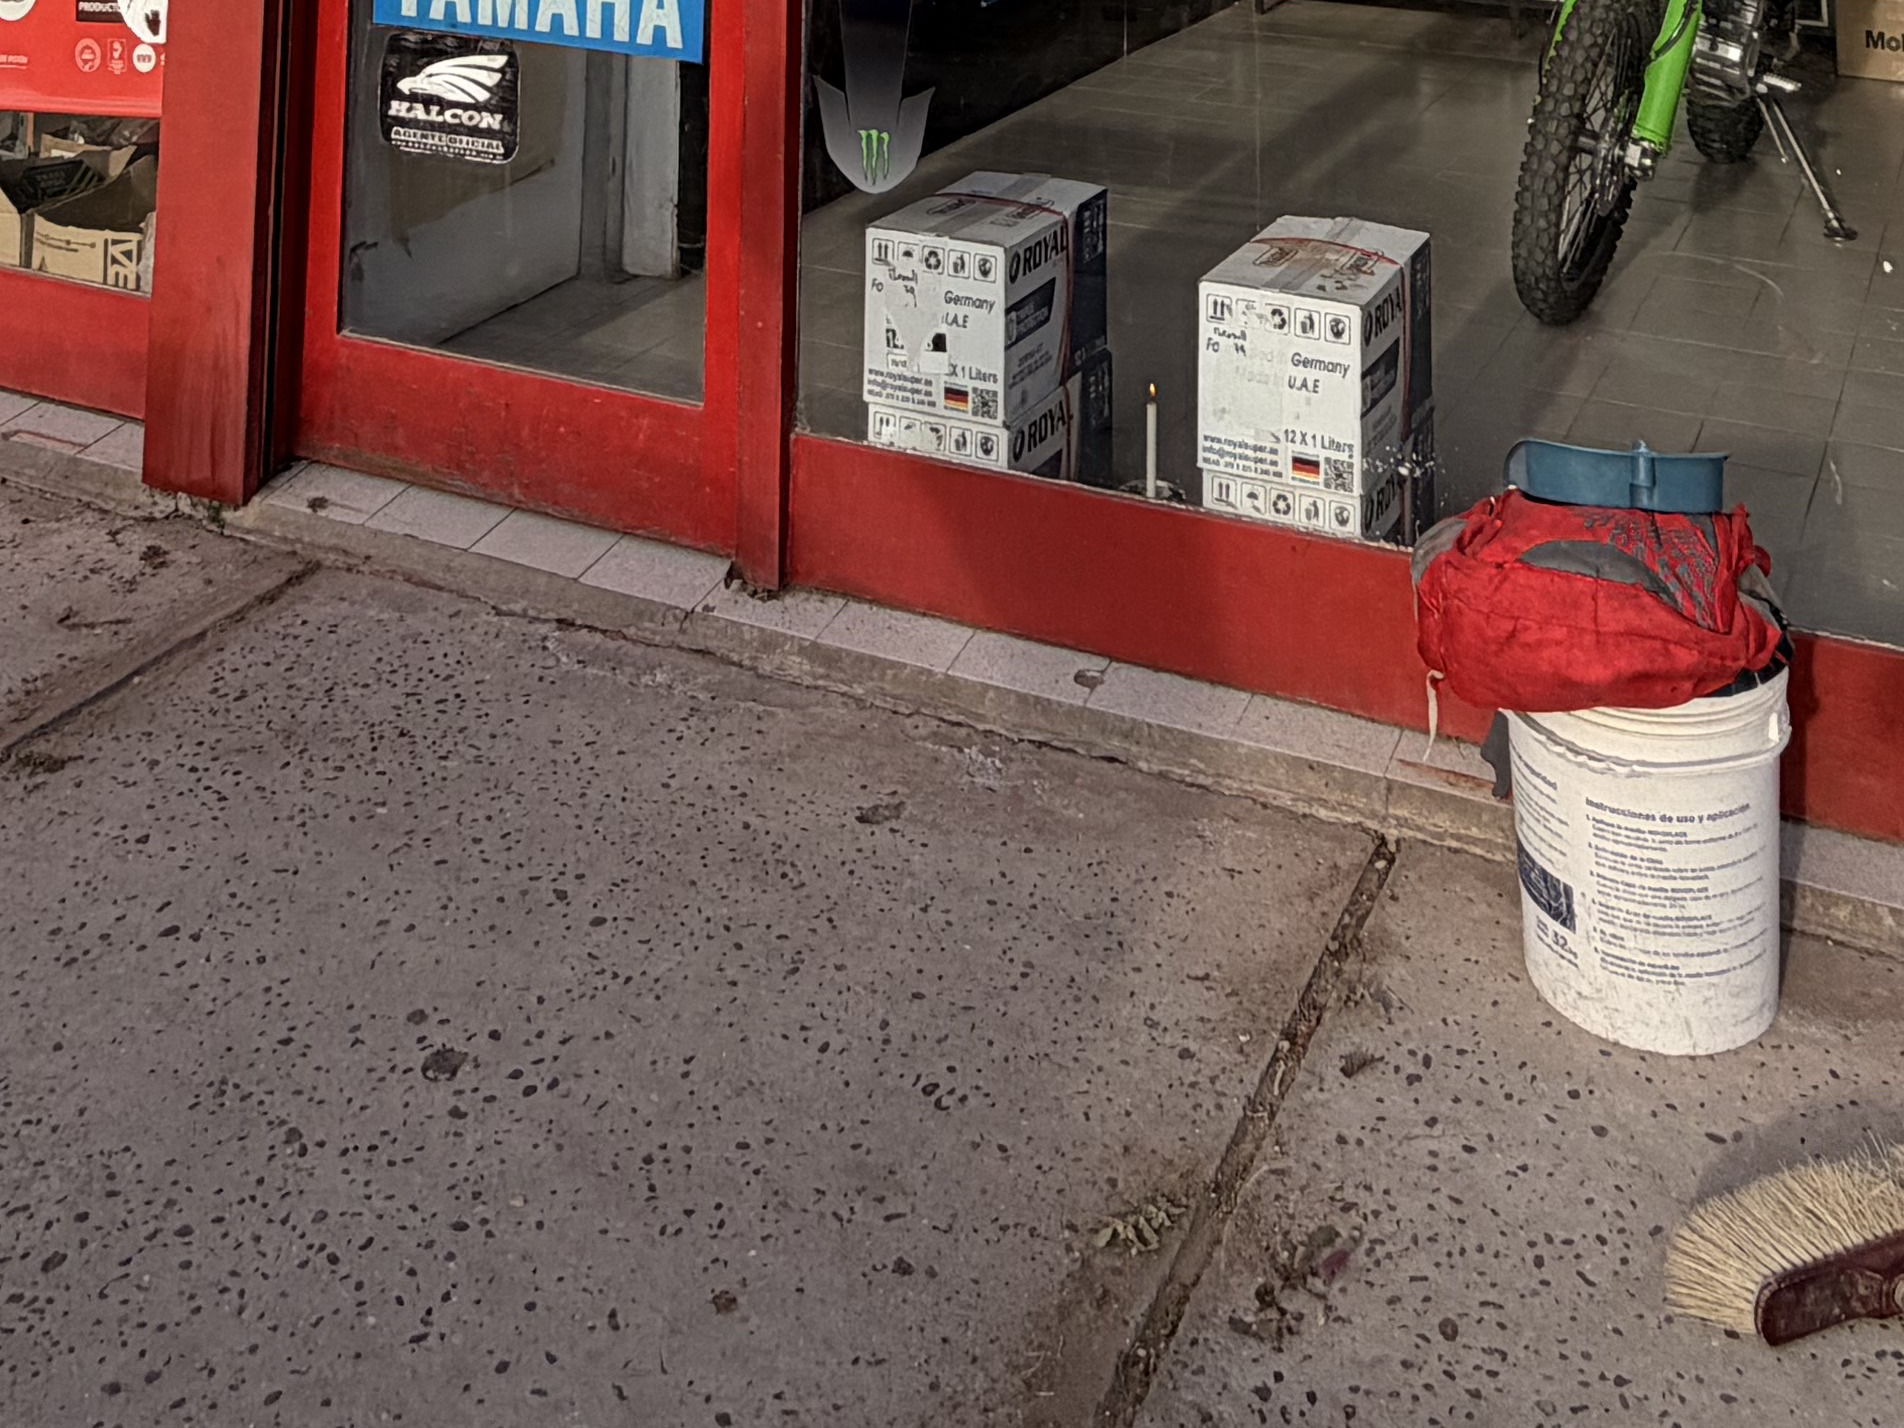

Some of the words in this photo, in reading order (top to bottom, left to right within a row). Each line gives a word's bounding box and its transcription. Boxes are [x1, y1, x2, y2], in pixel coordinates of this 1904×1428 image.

[388, 99, 504, 130] HALCON
[944, 290, 996, 314] Germany
[969, 366, 999, 384] Liters
[1291, 351, 1351, 379] Germany
[1288, 374, 1320, 394] U.A.E
[1283, 428, 1297, 444] 12
[1299, 431, 1309, 447] X
[1310, 434, 1317, 449] 1
[1320, 435, 1354, 455] Liters
[1676, 814, 1695, 825] uso
